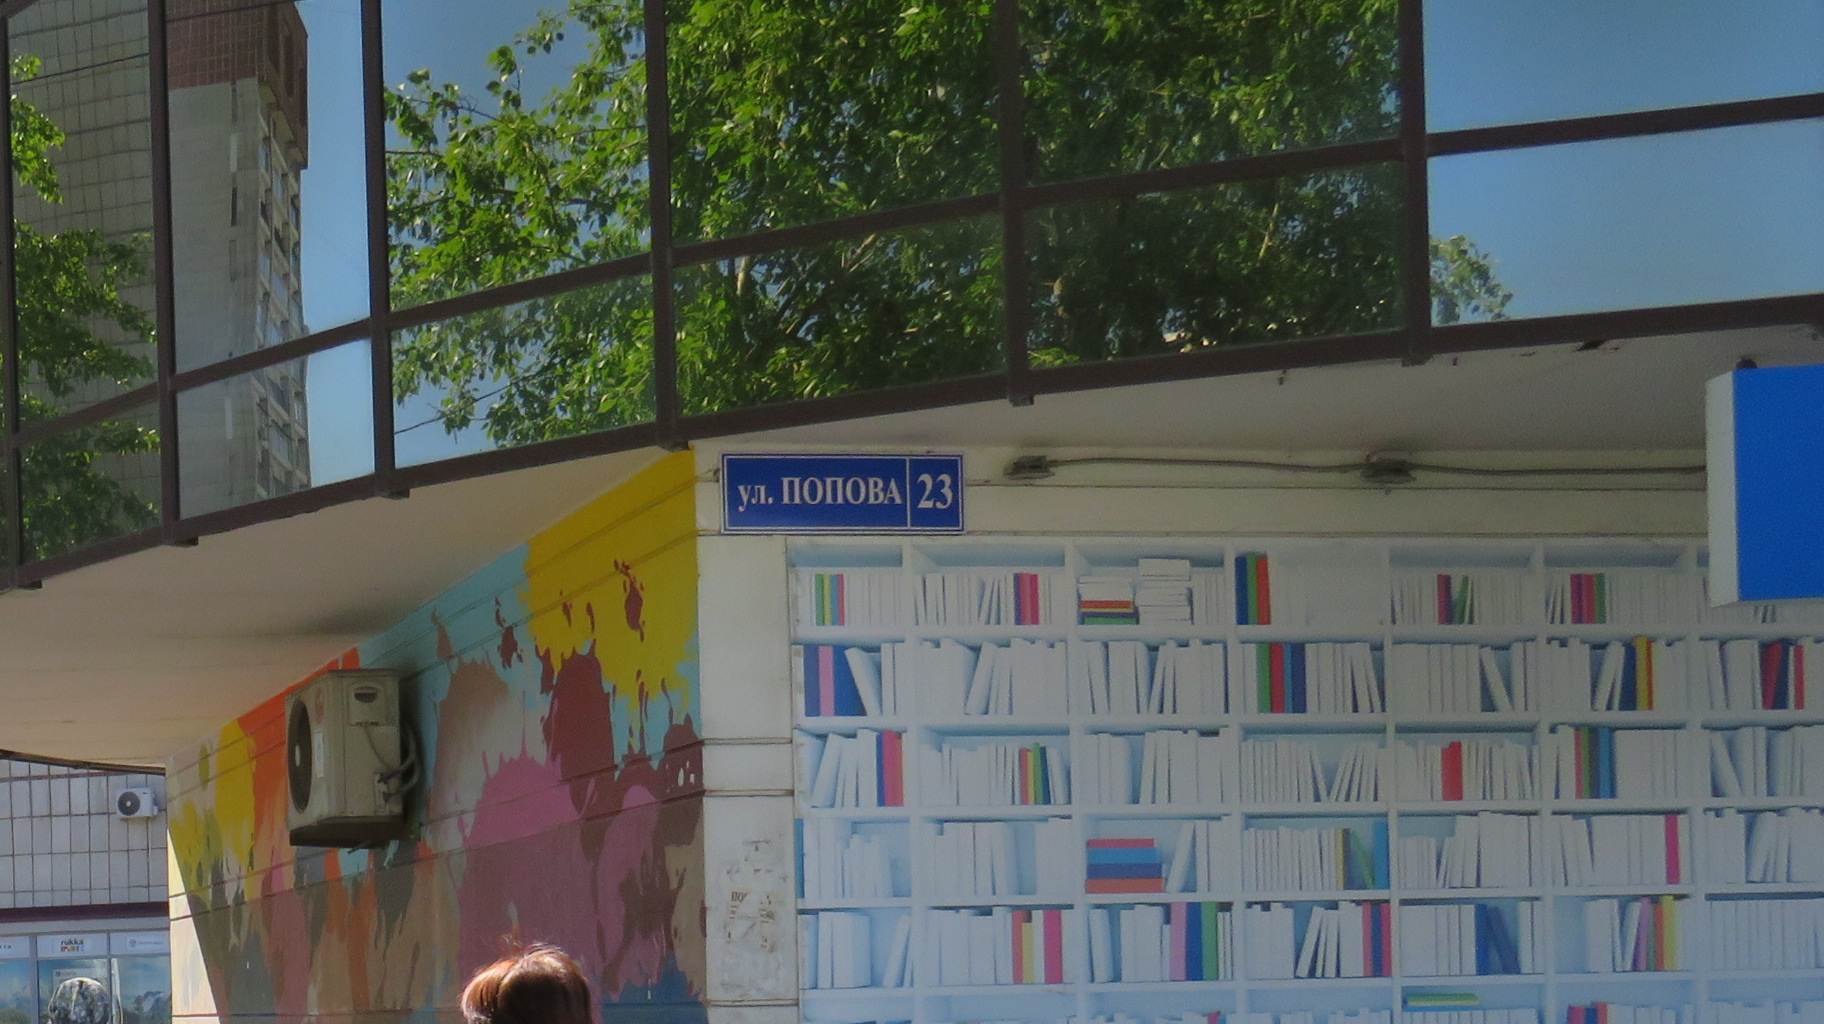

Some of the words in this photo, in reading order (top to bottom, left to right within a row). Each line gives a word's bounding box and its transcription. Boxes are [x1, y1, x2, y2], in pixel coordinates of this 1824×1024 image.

[737, 484, 773, 512] ул.
[780, 477, 903, 505] ПОПОВА
[916, 473, 953, 509] 23
